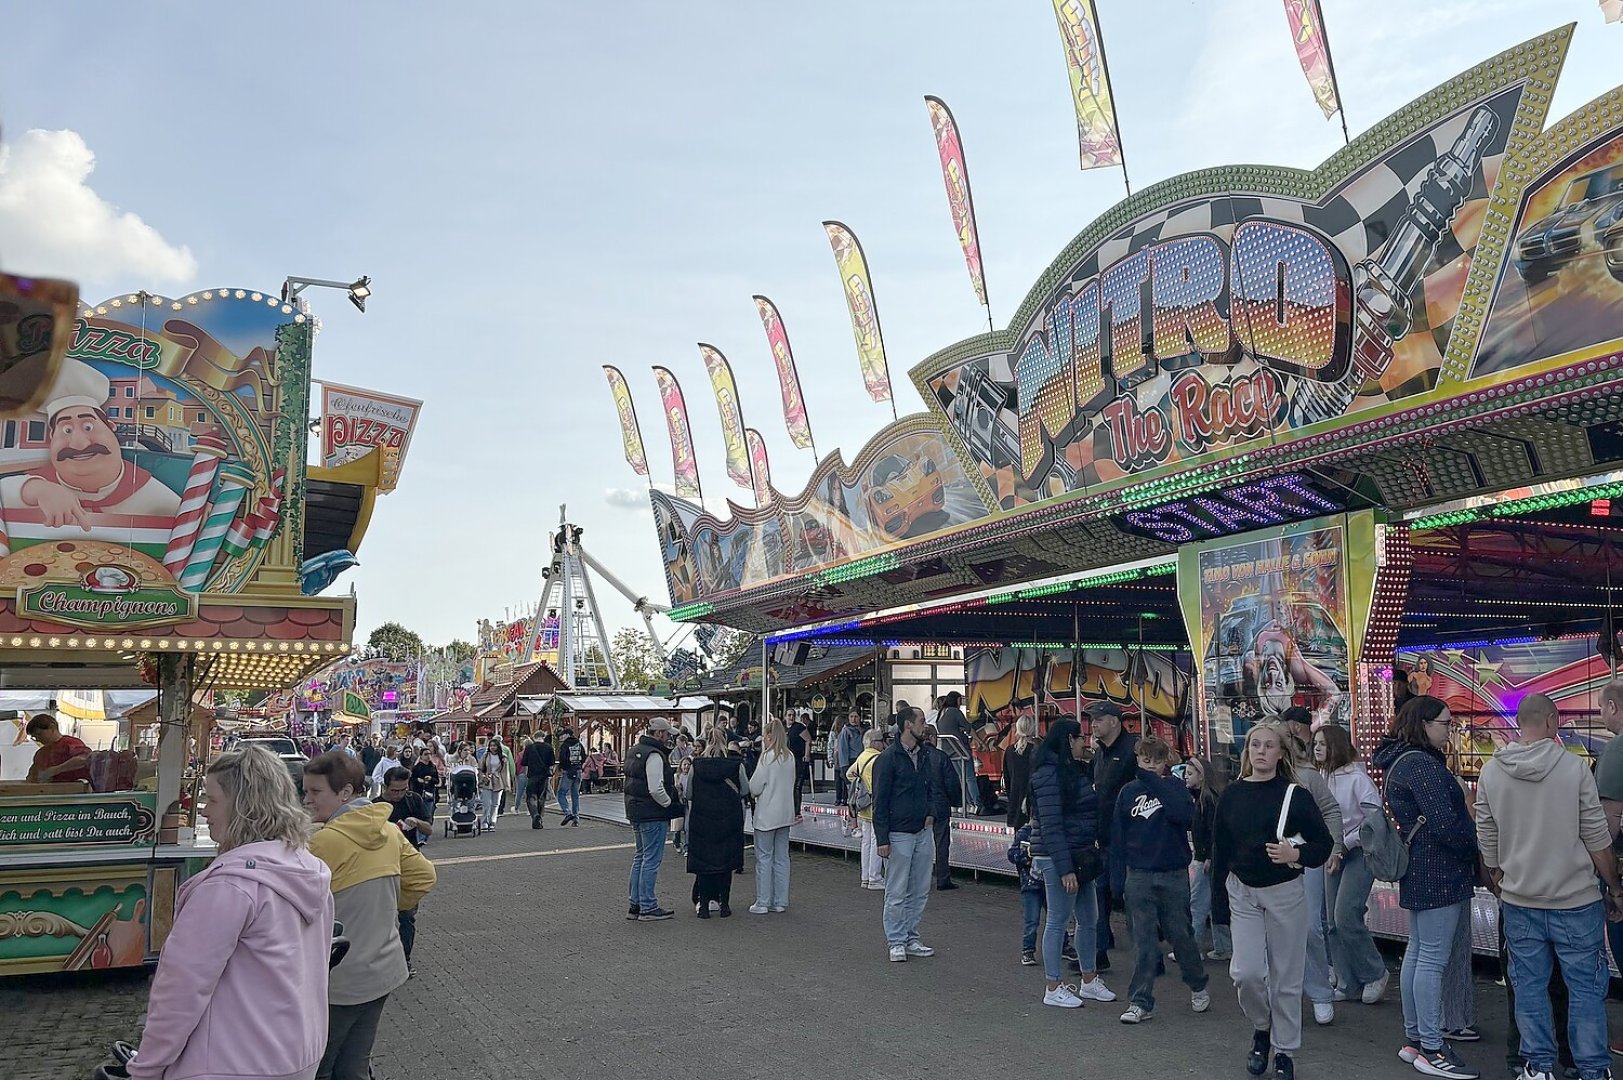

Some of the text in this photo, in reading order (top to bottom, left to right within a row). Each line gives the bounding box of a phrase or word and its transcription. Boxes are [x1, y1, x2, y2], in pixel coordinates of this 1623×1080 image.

[1013, 220, 1337, 481] NITRO
[1103, 369, 1284, 464] The Race
[1126, 474, 1337, 542] START
[39, 591, 177, 619] Champignons
[19, 827, 41, 840] und
[65, 826, 84, 838] bist
[86, 825, 104, 837] Du
[105, 824, 133, 837] auch.
[20, 810, 42, 822] und
[44, 808, 77, 821] Pizza
[78, 810, 92, 820] im
[93, 807, 132, 820] Bauch,
